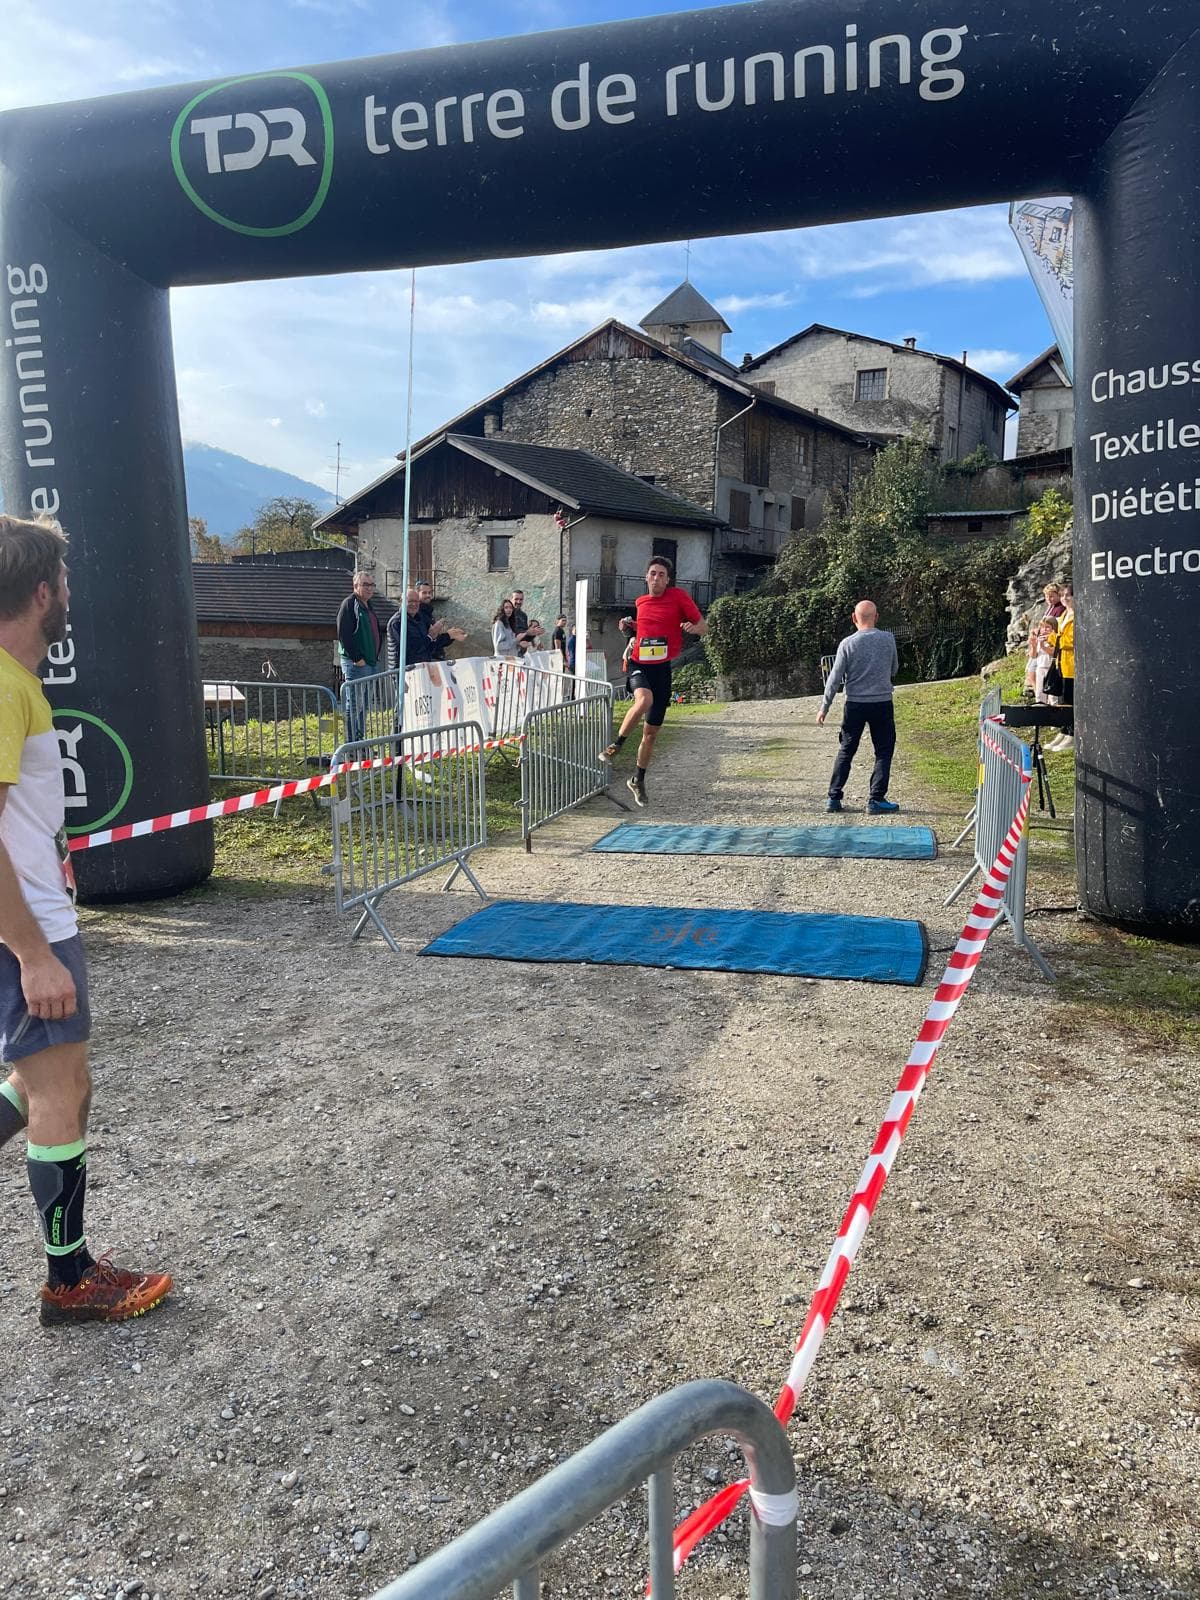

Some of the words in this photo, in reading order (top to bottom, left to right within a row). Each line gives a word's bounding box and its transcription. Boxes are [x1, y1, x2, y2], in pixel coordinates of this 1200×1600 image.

[364, 88, 525, 155] terre
[551, 61, 637, 131] de
[665, 23, 969, 117] running
[190, 106, 317, 175] TDR
[5, 263, 56, 468] running
[1089, 418, 1200, 463] Textile
[1091, 478, 1200, 524] Diététi
[1091, 546, 1200, 582] Electro
